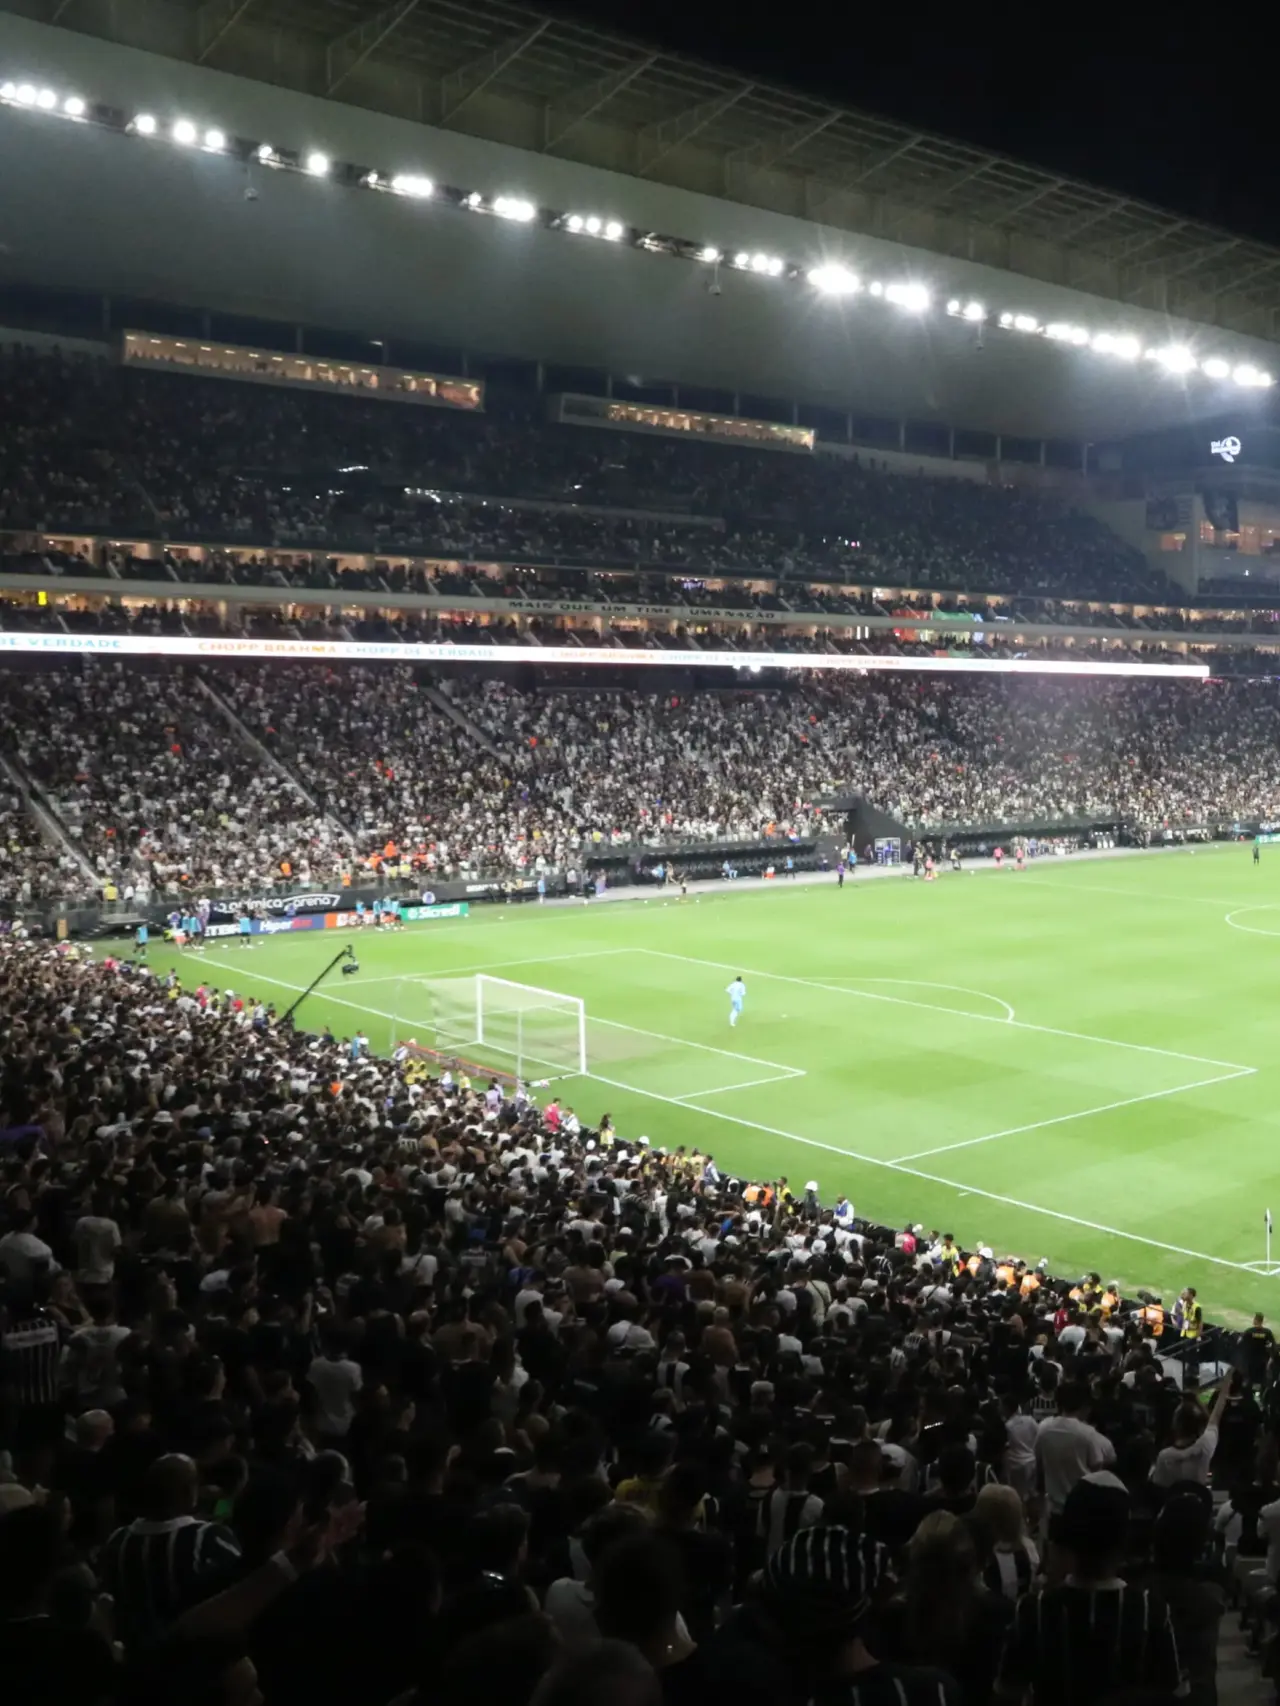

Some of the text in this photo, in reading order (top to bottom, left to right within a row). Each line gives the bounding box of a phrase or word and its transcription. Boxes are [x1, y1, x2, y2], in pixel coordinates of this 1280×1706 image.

[508, 600, 672, 615] MAIS QUE UM TIME
[689, 608, 721, 617] UMA
[27, 637, 122, 649] VERDADE
[198, 641, 259, 652] CHOPP
[264, 643, 337, 654] BRAHMA
[292, 896, 331, 909] arena
